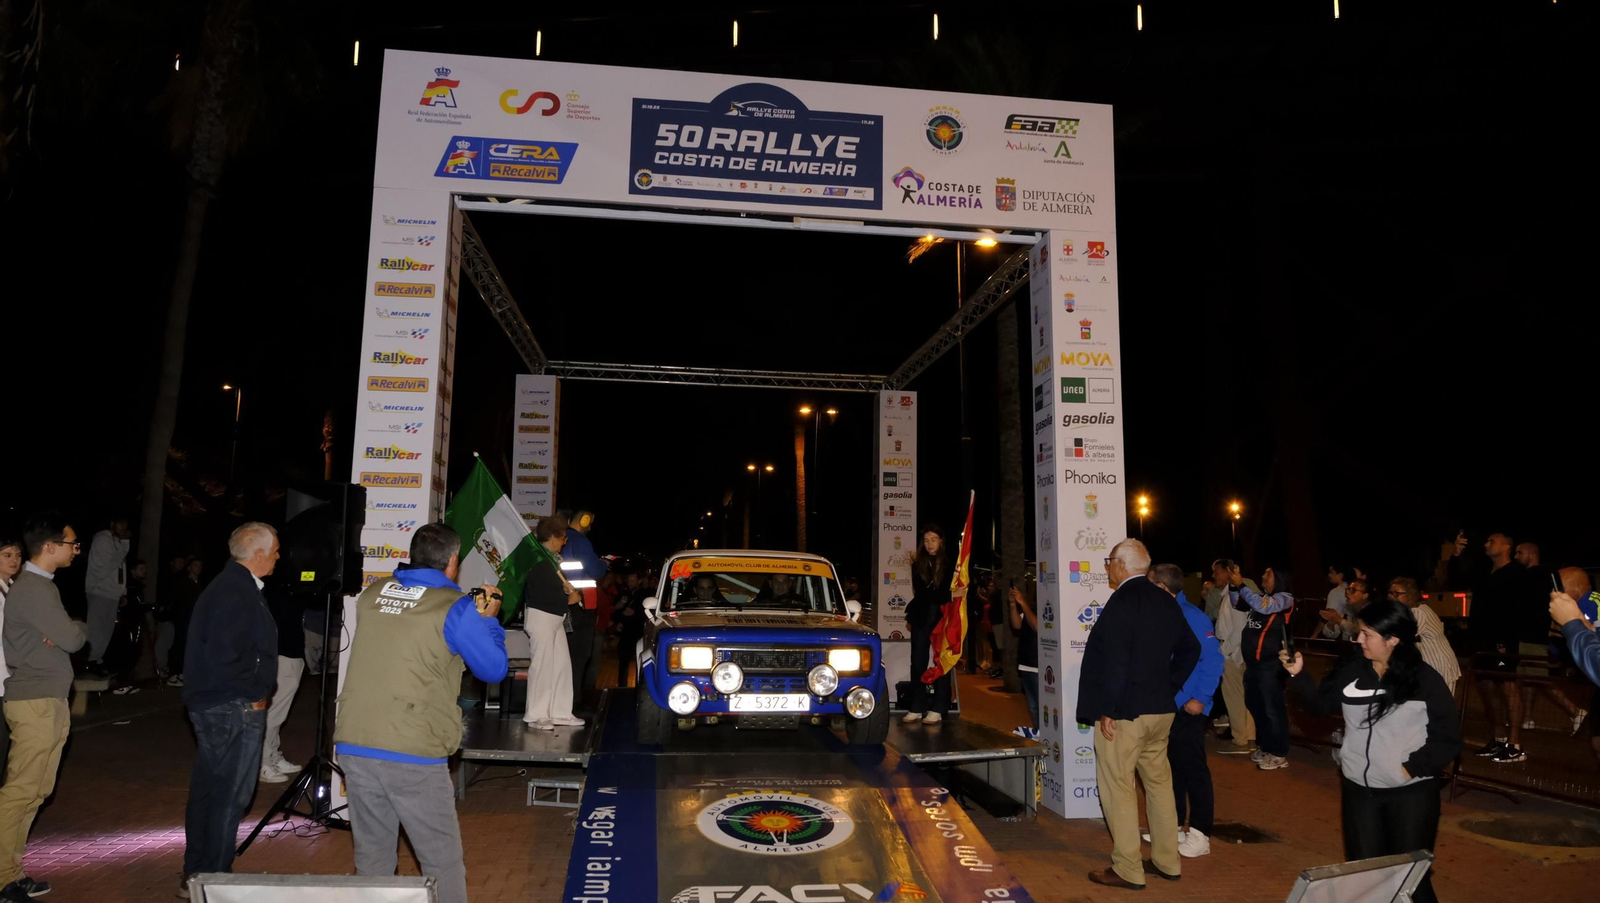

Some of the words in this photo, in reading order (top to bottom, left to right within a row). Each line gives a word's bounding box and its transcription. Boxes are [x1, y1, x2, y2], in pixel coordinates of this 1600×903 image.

[567, 102, 590, 110] Consejo
[655, 123, 704, 149] 50
[706, 127, 860, 159] RALLYE
[489, 144, 560, 160] CERA
[654, 152, 725, 168] COSTA
[729, 156, 756, 171] DE
[761, 160, 857, 177] ALMERÍA
[502, 166, 546, 178] Recalvi
[928, 181, 965, 193] COSTA
[967, 184, 982, 194] DE
[916, 193, 983, 209] ALMERÍA
[1022, 190, 1095, 204] DIPUTACIÓN
[1023, 202, 1038, 212] DE
[1041, 201, 1093, 215] ALMERÍA
[380, 258, 434, 271] Rallycar
[386, 285, 423, 294] Recalvi
[373, 352, 428, 365] Rallycar
[1061, 351, 1113, 366] MOYA
[379, 380, 417, 389] Recalvi
[1062, 412, 1115, 427] gasolia
[366, 447, 422, 460] Rallycar
[372, 475, 410, 485] Recalvi
[1065, 469, 1116, 484] Phonika
[883, 491, 913, 500] gasolia
[884, 523, 913, 532] Phonika
[670, 563, 692, 580] 54
[375, 597, 417, 608] FOTO/TV
[379, 605, 402, 615] 2025
[734, 696, 742, 709] Z
[755, 697, 788, 709] 5372
[798, 696, 805, 708] K
[707, 795, 793, 816] AUTOMOVIL
[803, 799, 839, 816] CLUB
[739, 843, 825, 853] ALMERIA
